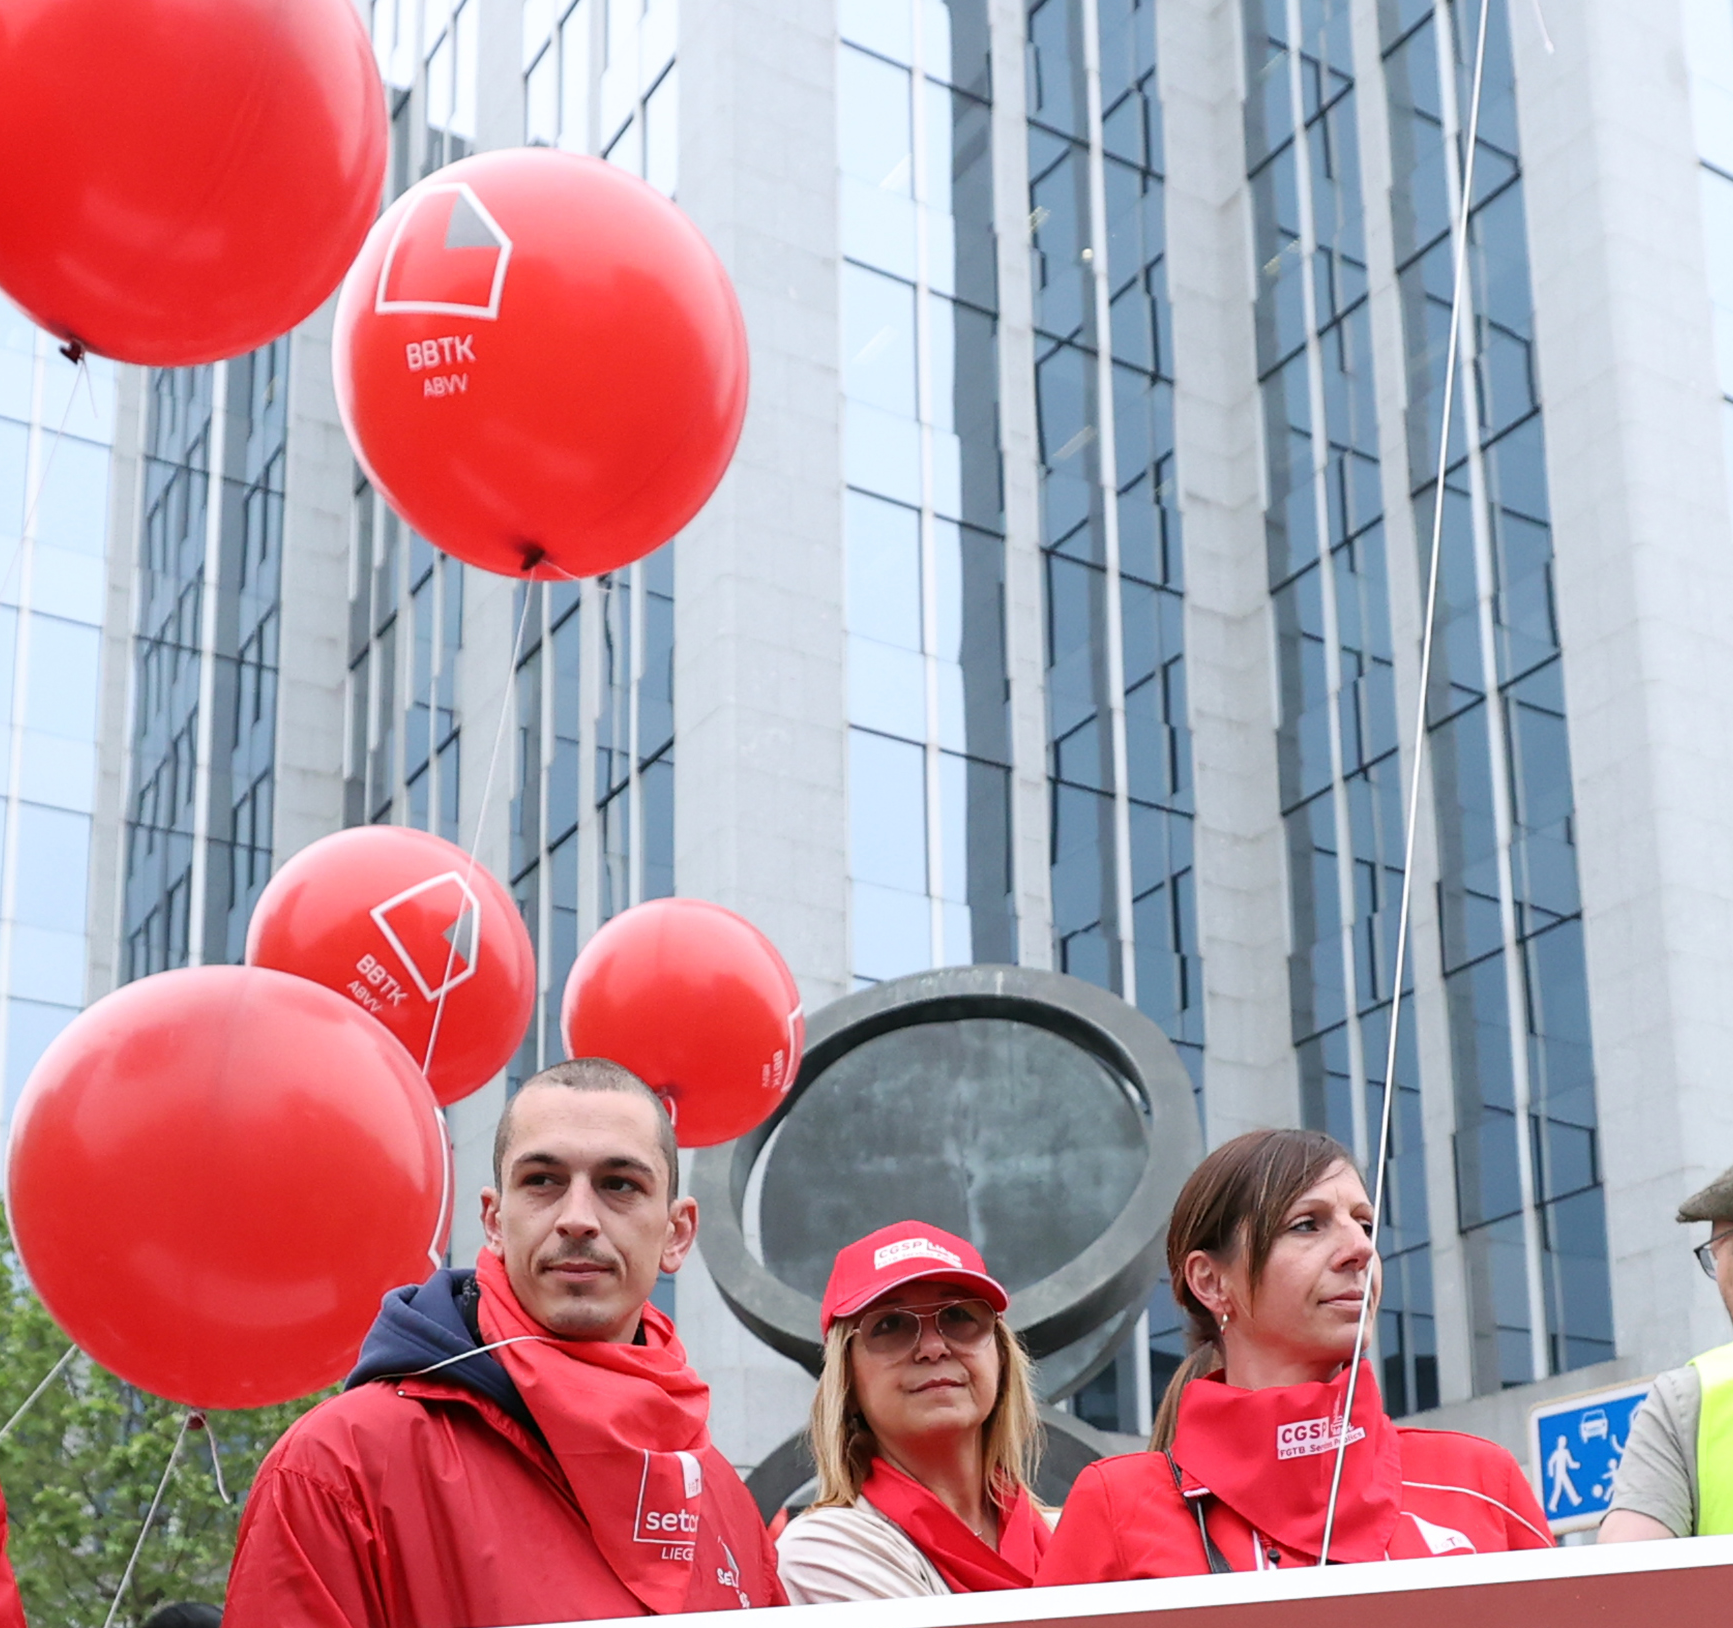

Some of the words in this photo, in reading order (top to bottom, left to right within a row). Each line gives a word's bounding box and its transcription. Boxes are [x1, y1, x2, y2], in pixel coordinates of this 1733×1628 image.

[405, 333, 477, 372] BBTK
[422, 372, 469, 398] ABVV
[355, 953, 409, 1008] BBTK
[346, 979, 384, 1013] ABVV
[878, 1240, 924, 1259] CGSP
[1281, 1421, 1328, 1444] CGSP
[661, 1546, 695, 1562] LIEG
